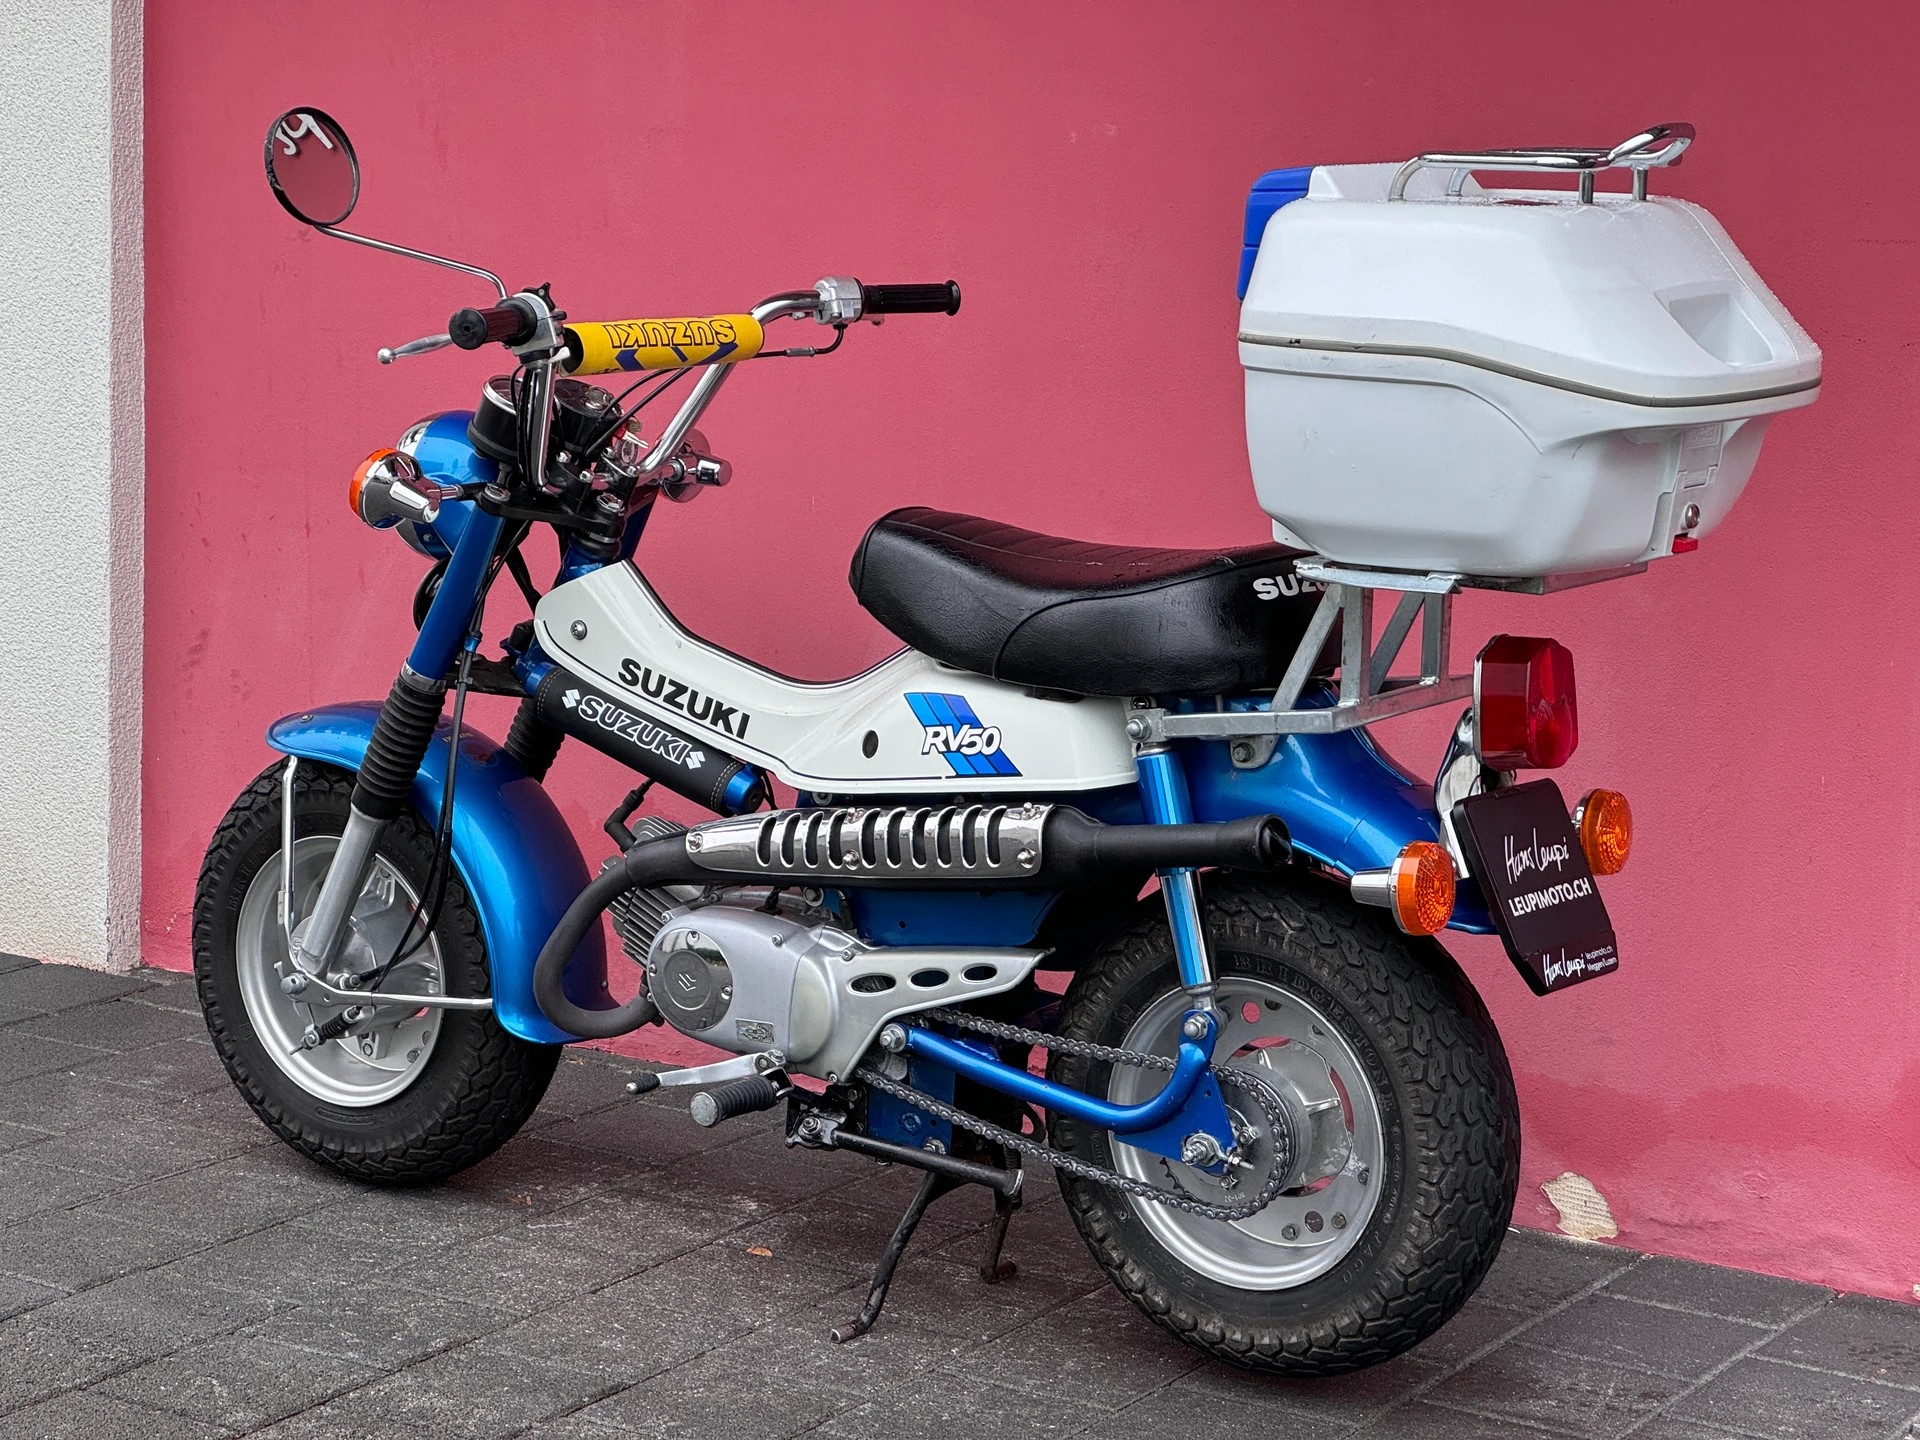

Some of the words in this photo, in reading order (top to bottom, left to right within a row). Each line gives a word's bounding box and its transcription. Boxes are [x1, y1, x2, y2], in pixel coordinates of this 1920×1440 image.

[602, 319, 737, 349] SUZUKI
[618, 657, 751, 740] SUZUKI
[578, 695, 693, 765] SUZUKI
[921, 724, 1002, 756] RV50
[1504, 835, 1536, 885] Hans
[1533, 827, 1570, 872] Leupi
[1508, 877, 1593, 917] LEUPIMOTO.CH
[1542, 953, 1564, 987] Hans
[1561, 947, 1586, 978] Leupi
[1233, 953, 1395, 1113] BRIDGESTONE
